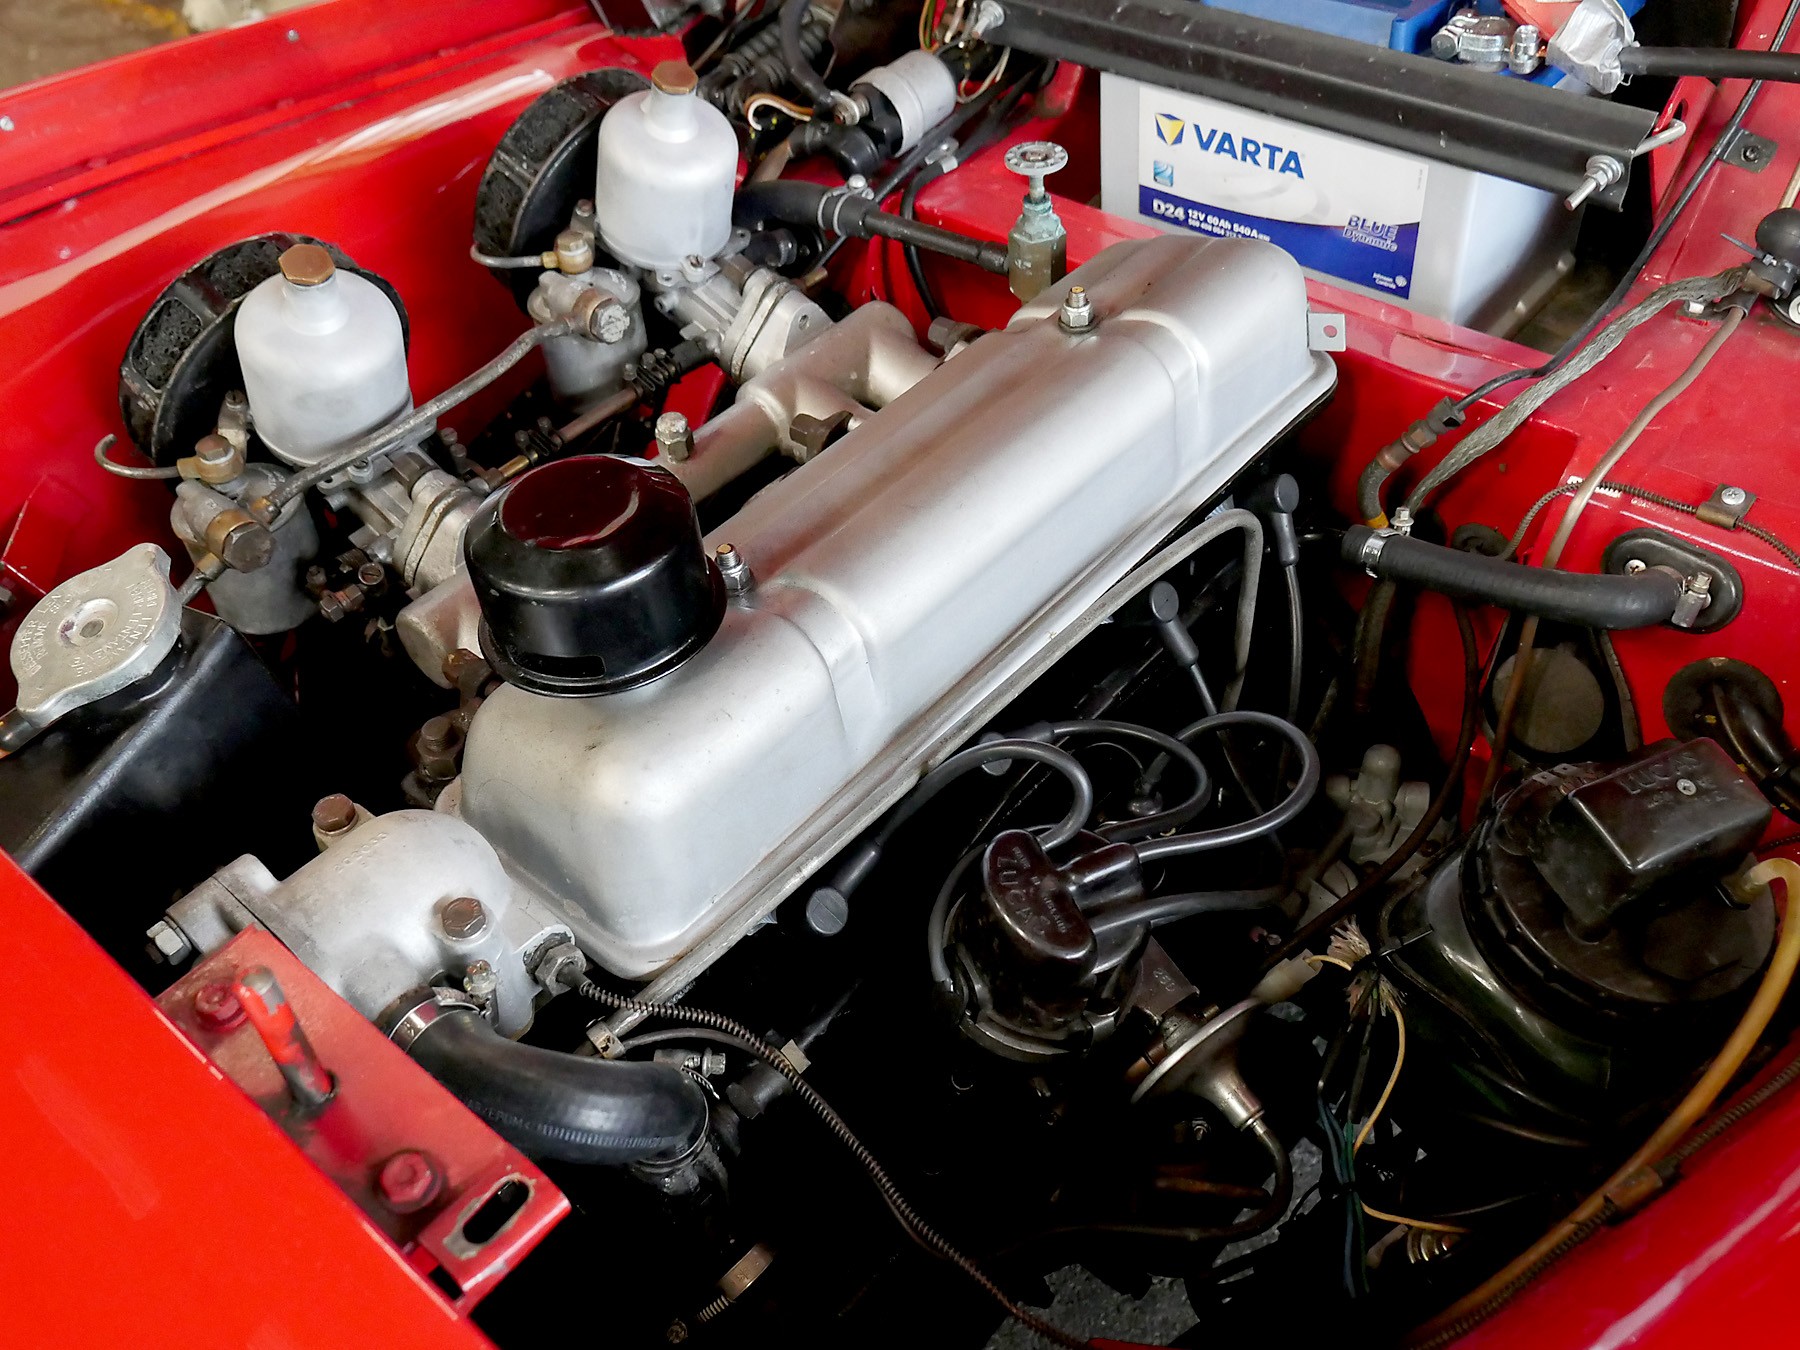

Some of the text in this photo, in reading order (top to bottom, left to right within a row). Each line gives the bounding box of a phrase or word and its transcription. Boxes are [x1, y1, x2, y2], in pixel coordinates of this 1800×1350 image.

[1192, 124, 1305, 180] VARTA
[1153, 198, 1186, 221] D24
[1187, 208, 1206, 222] 12V
[1206, 214, 1232, 231] 60Ah
[1347, 215, 1399, 240] BLUE
[1343, 228, 1398, 253] Dynamic
